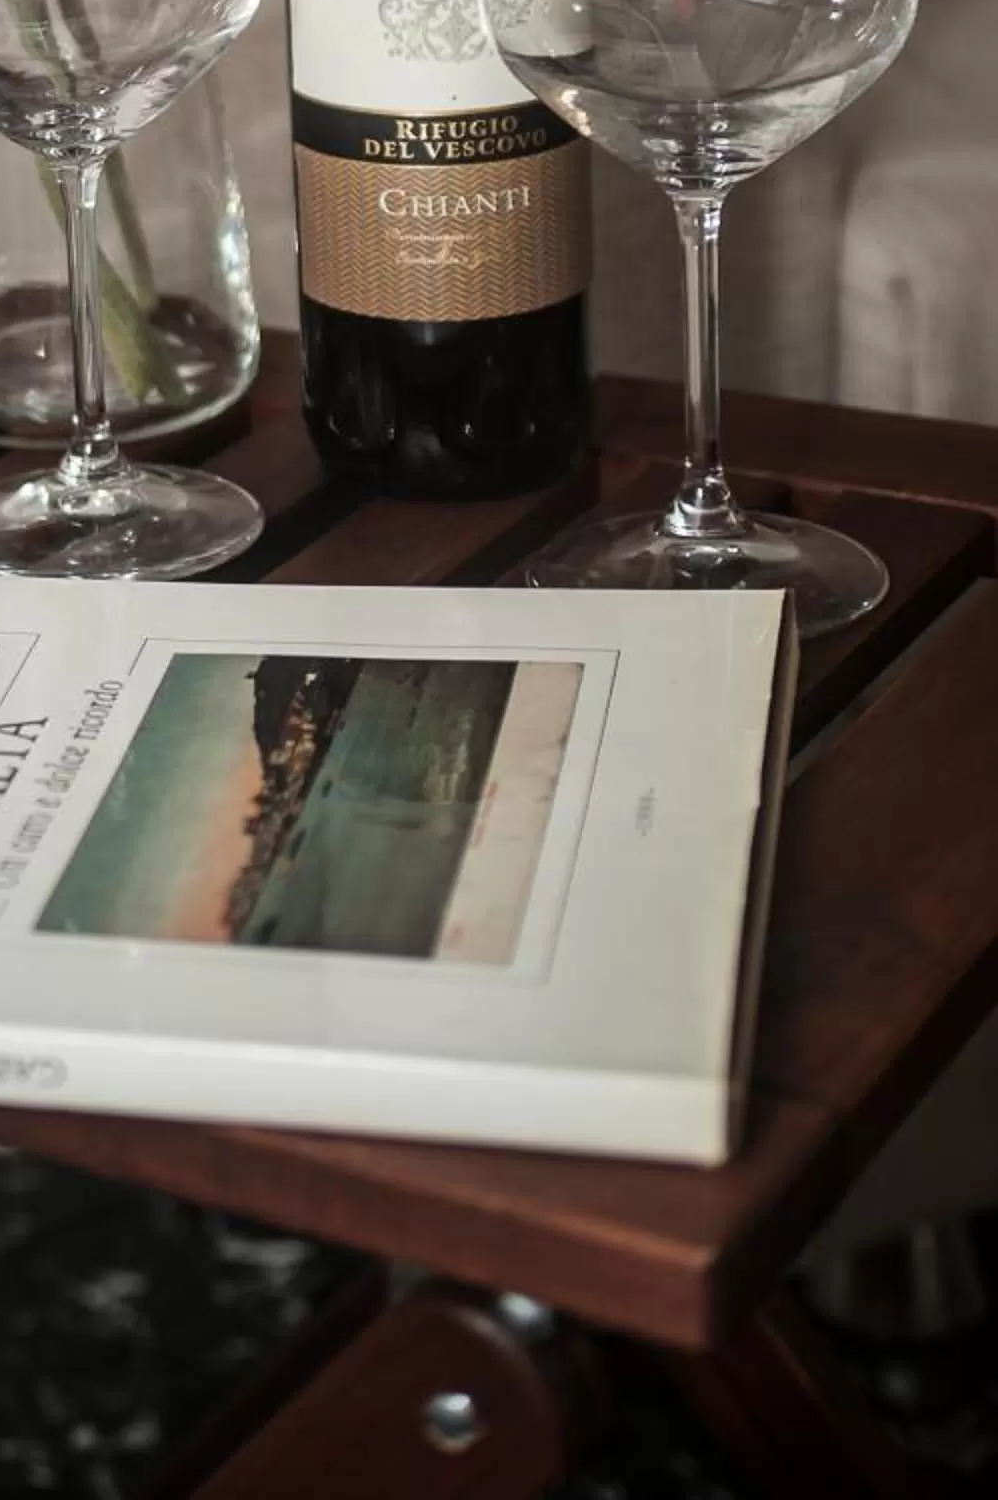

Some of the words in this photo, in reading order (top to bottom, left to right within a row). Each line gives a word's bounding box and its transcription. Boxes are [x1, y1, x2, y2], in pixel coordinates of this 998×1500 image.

[364, 138, 415, 160] DEL
[423, 127, 548, 161] VESCOVO
[395, 115, 519, 141] RIFUGIO
[378, 186, 531, 218] CHIANTI
[68, 678, 125, 741] ricordo
